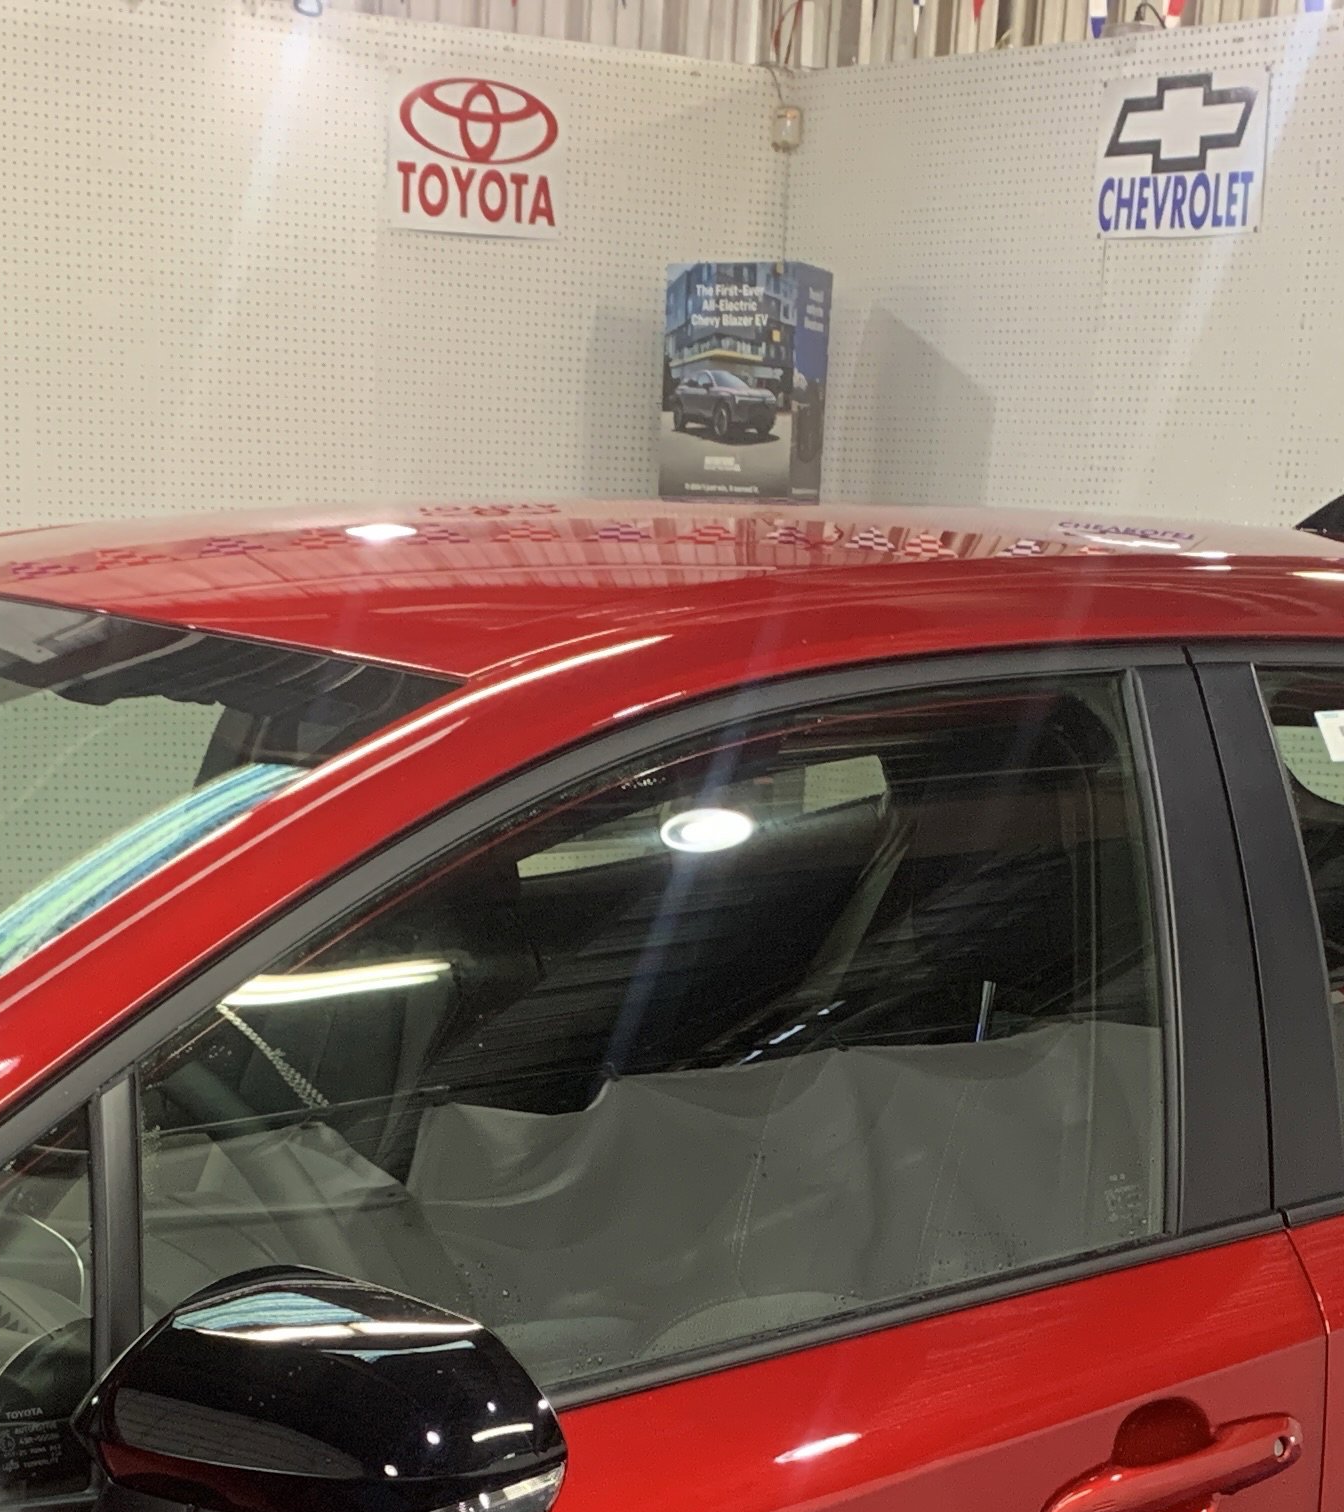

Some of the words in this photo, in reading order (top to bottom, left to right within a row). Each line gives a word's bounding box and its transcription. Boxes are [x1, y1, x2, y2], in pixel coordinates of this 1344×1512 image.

[396, 160, 558, 229] TOYOTA
[1096, 170, 1253, 235] CHEVROLET
[696, 284, 713, 297] The
[715, 283, 764, 298] First-Ever
[702, 299, 757, 312] All-Electric
[691, 314, 720, 328] Chevy
[722, 314, 753, 326] Blazer
[755, 314, 768, 326] EV
[5, 1407, 44, 1420] TOYOTA
